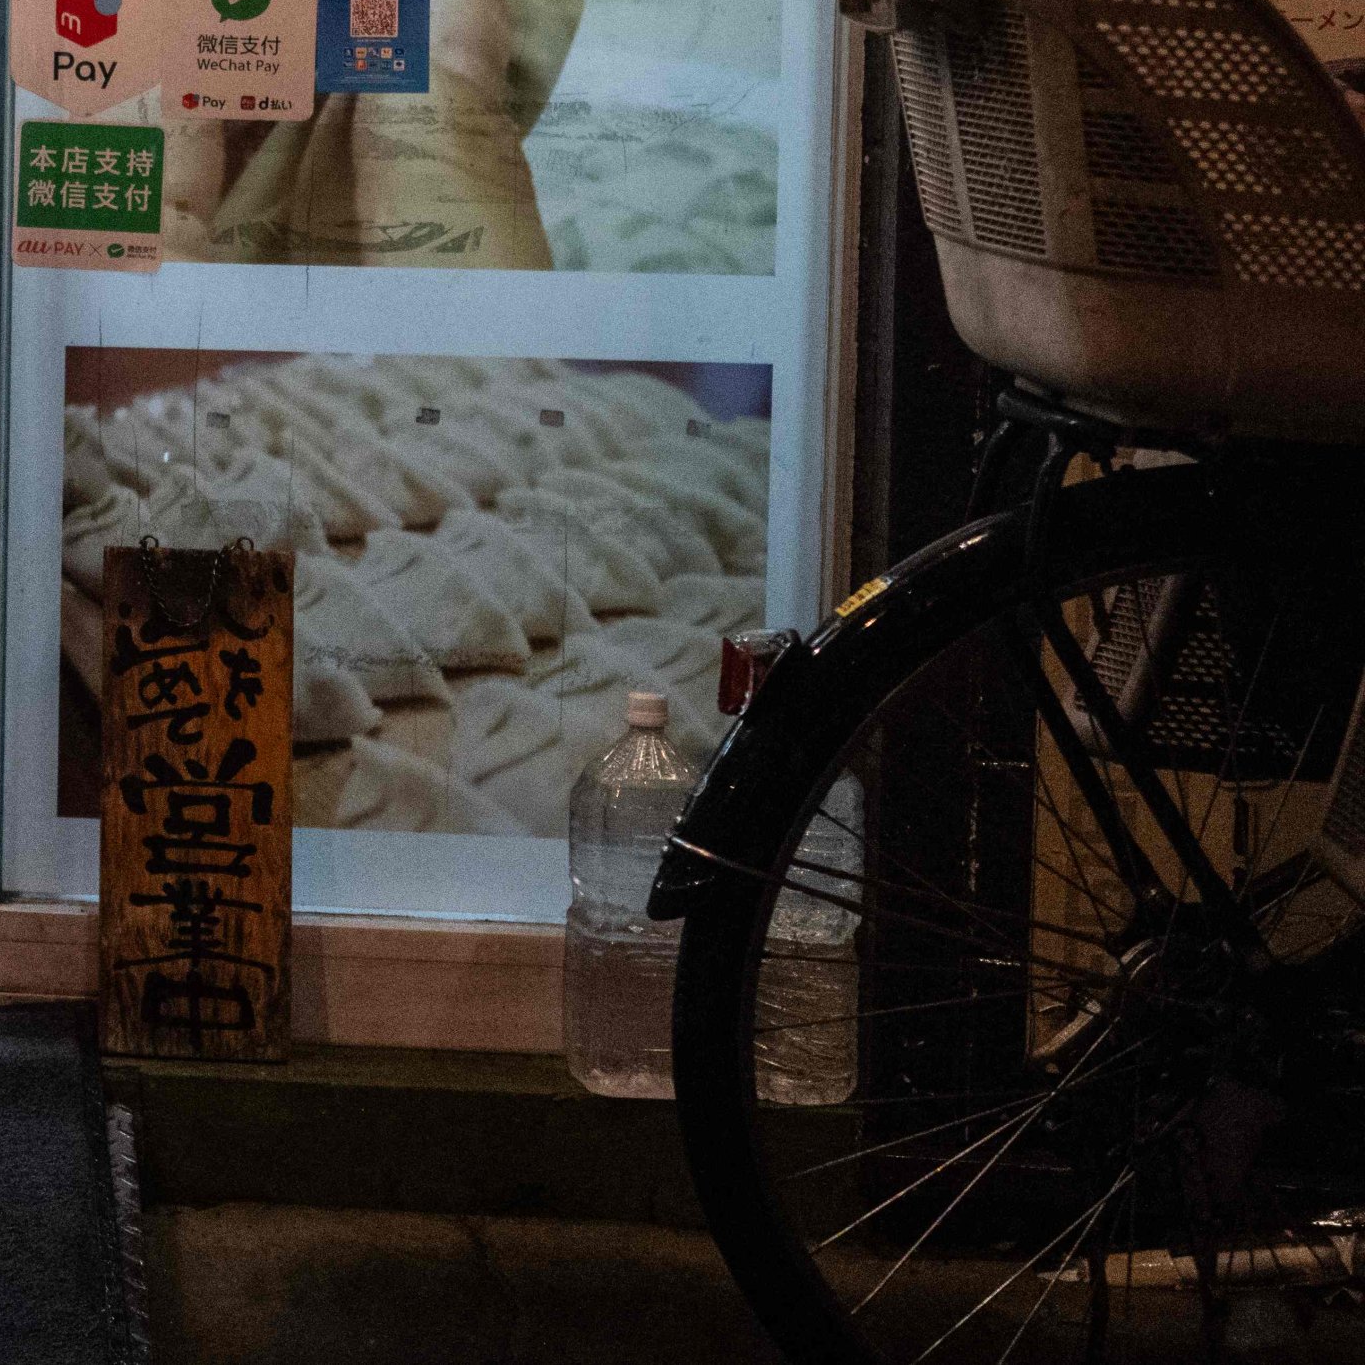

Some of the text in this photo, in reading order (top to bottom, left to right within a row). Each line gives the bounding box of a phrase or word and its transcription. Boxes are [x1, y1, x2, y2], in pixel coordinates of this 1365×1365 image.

[197, 34, 282, 56] 微信支付
[52, 51, 118, 89] Pay
[197, 57, 281, 76] WeChat Pay
[202, 95, 227, 111] Pay
[258, 96, 294, 112] d払い
[29, 145, 154, 178] 本店支持
[27, 180, 153, 213] 微信支付
[17, 239, 84, 256] au PAY
[113, 736, 275, 1047] 営業中
